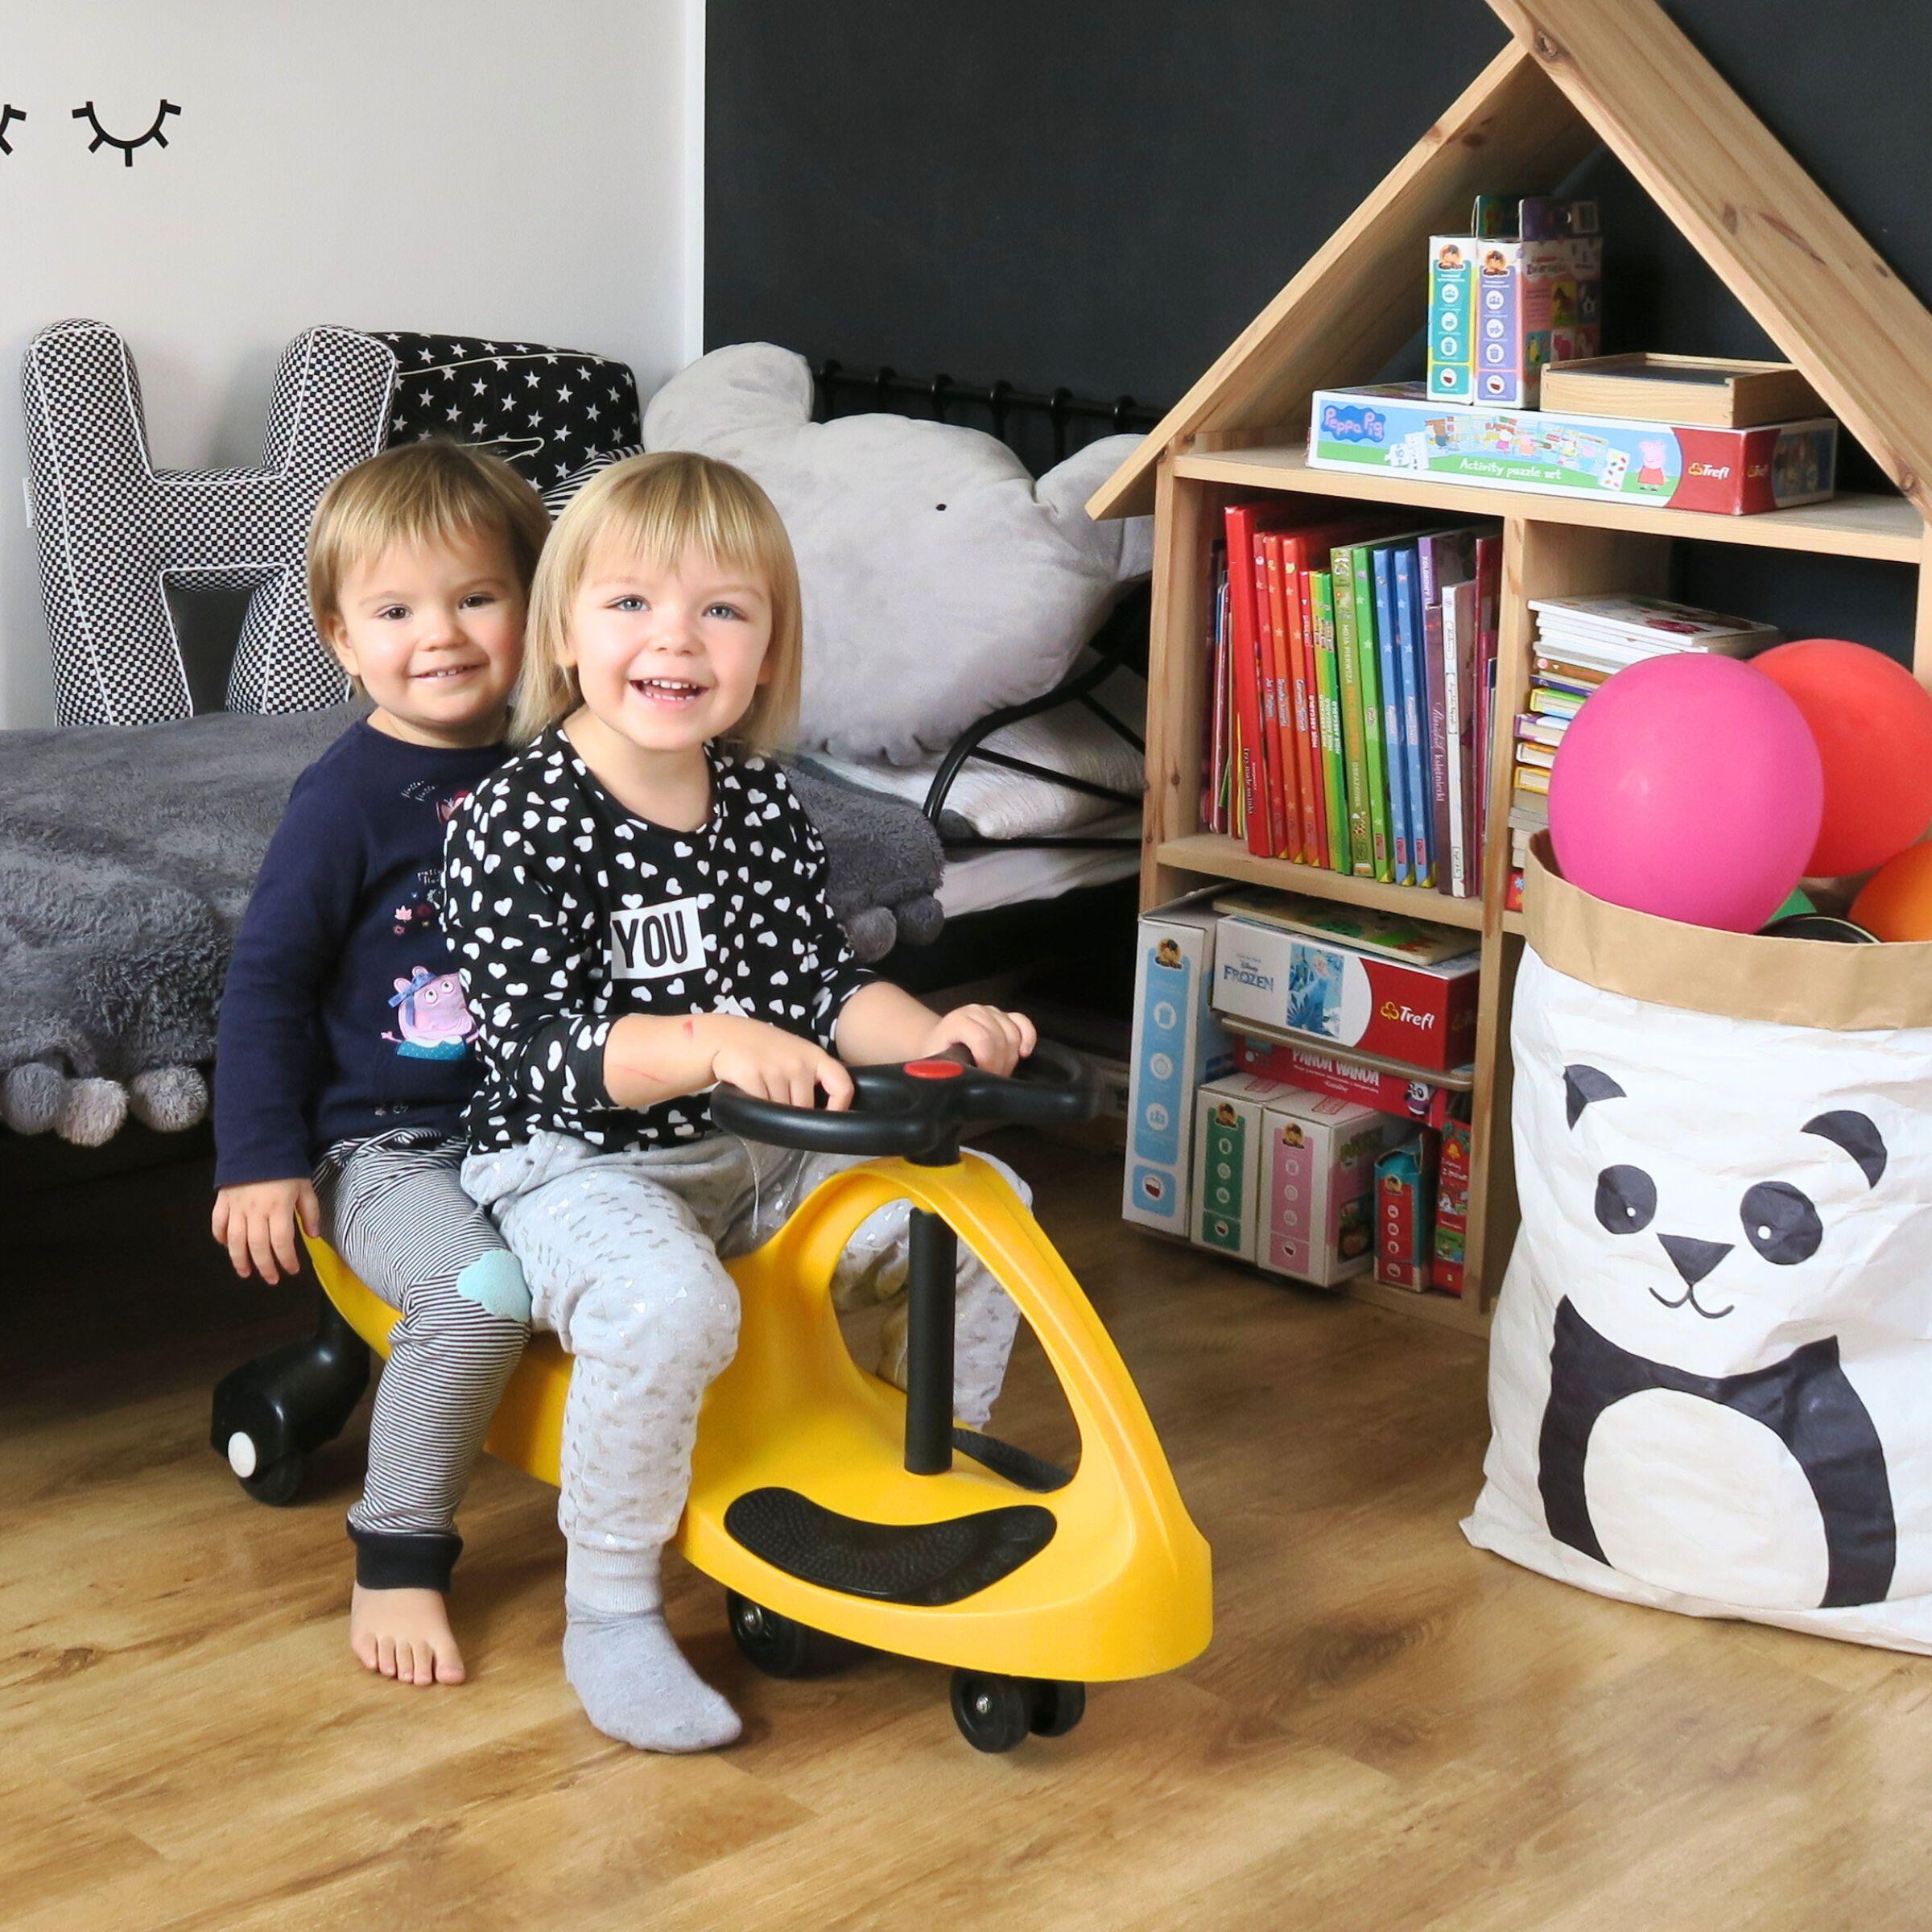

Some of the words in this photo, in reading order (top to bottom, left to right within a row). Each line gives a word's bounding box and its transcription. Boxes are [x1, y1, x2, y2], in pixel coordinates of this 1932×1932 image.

[1324, 407, 1363, 436] Peppa
[1364, 411, 1384, 440] Pig
[1459, 458, 1505, 477] Activity
[1505, 464, 1542, 478] puzzle
[1544, 469, 1563, 480] set
[1702, 464, 1731, 480] Trefl
[1342, 625, 1350, 645] MOJA
[1343, 646, 1353, 683] PIERWSZA
[612, 910, 688, 969] YOU
[1224, 965, 1274, 992] FROZEN
[1400, 1005, 1435, 1030] Trefl
